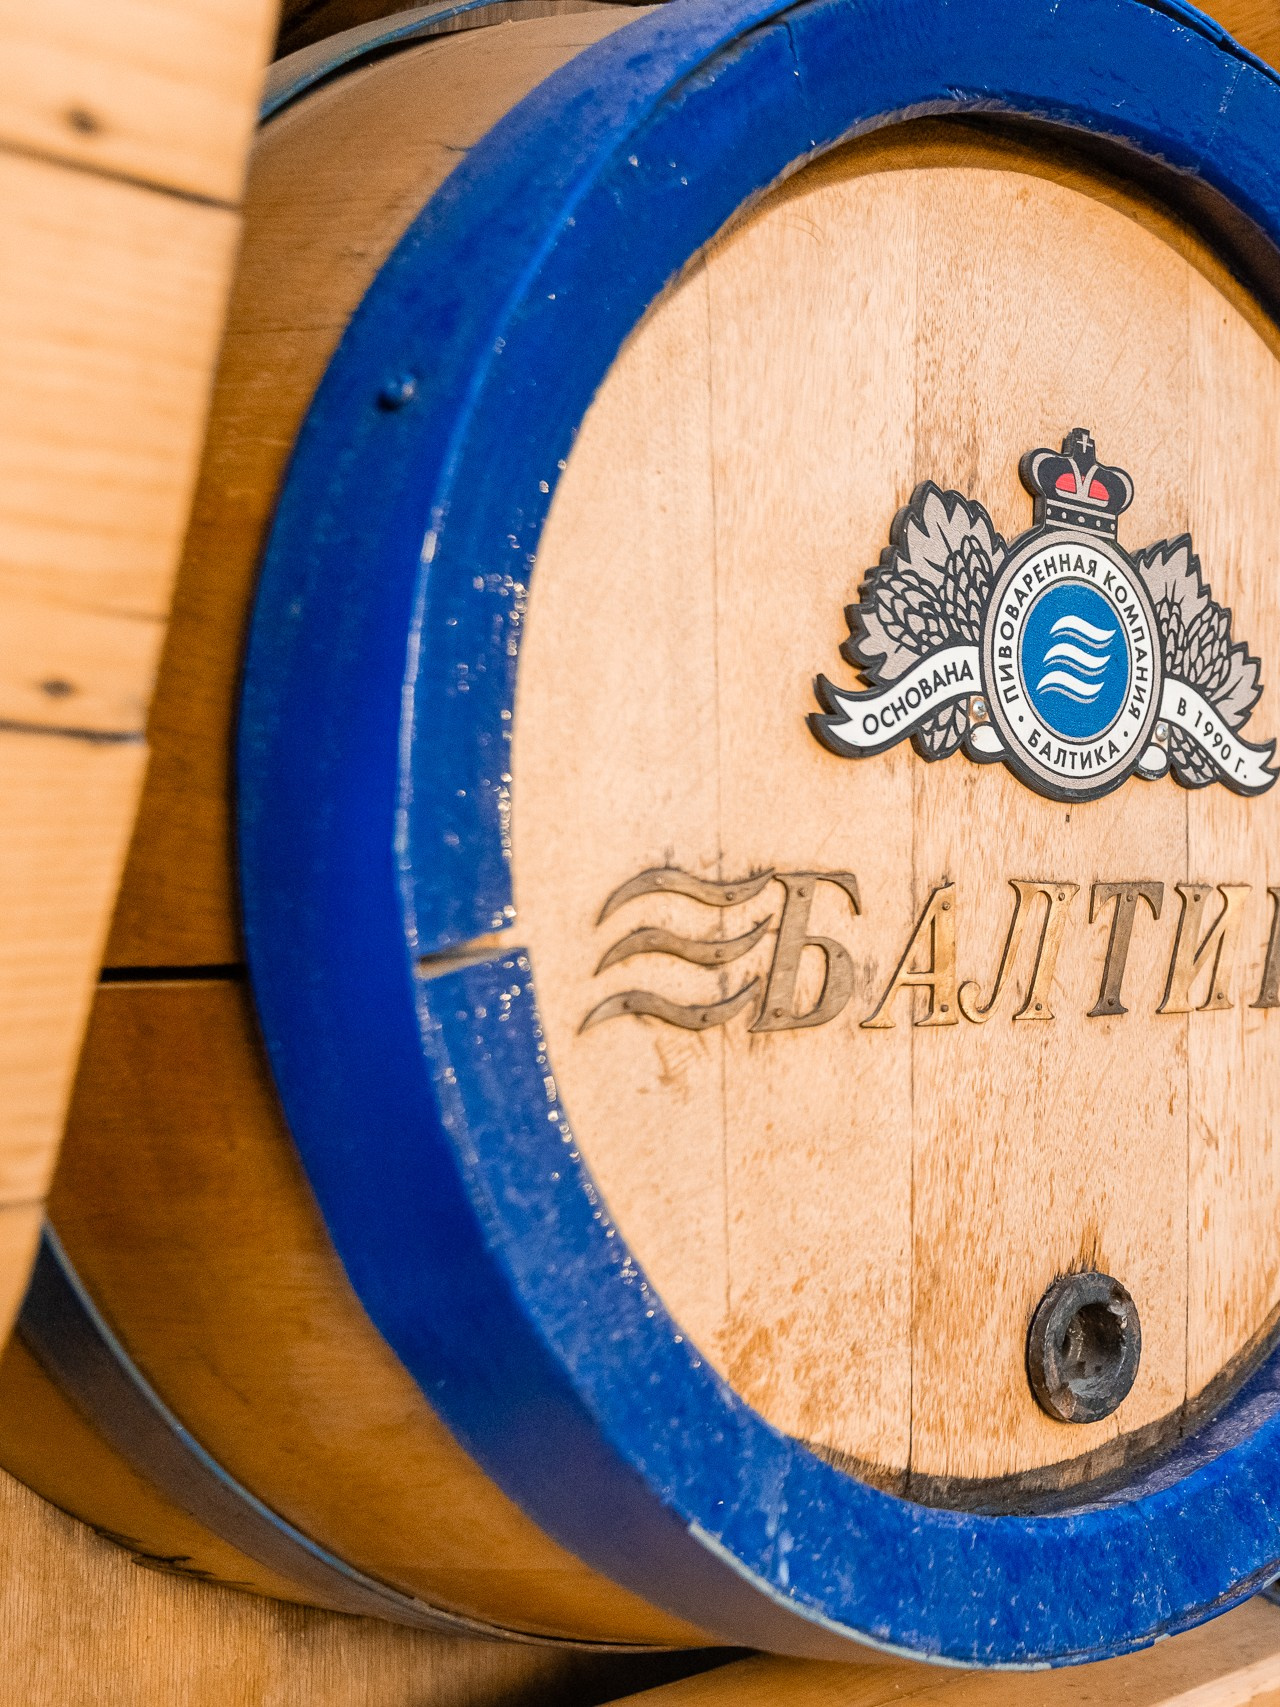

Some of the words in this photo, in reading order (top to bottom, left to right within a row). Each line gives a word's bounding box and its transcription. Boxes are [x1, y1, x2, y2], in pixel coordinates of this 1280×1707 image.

[999, 553, 1098, 704] ПИВОВАРЕННАЯ
[1103, 570, 1149, 721] КОМПАНИЯ
[862, 659, 974, 735] ОСНОВАНА
[1176, 697, 1187, 716] В
[1194, 710, 1231, 760] 1990
[1027, 728, 1121, 771] БАЛТИКА
